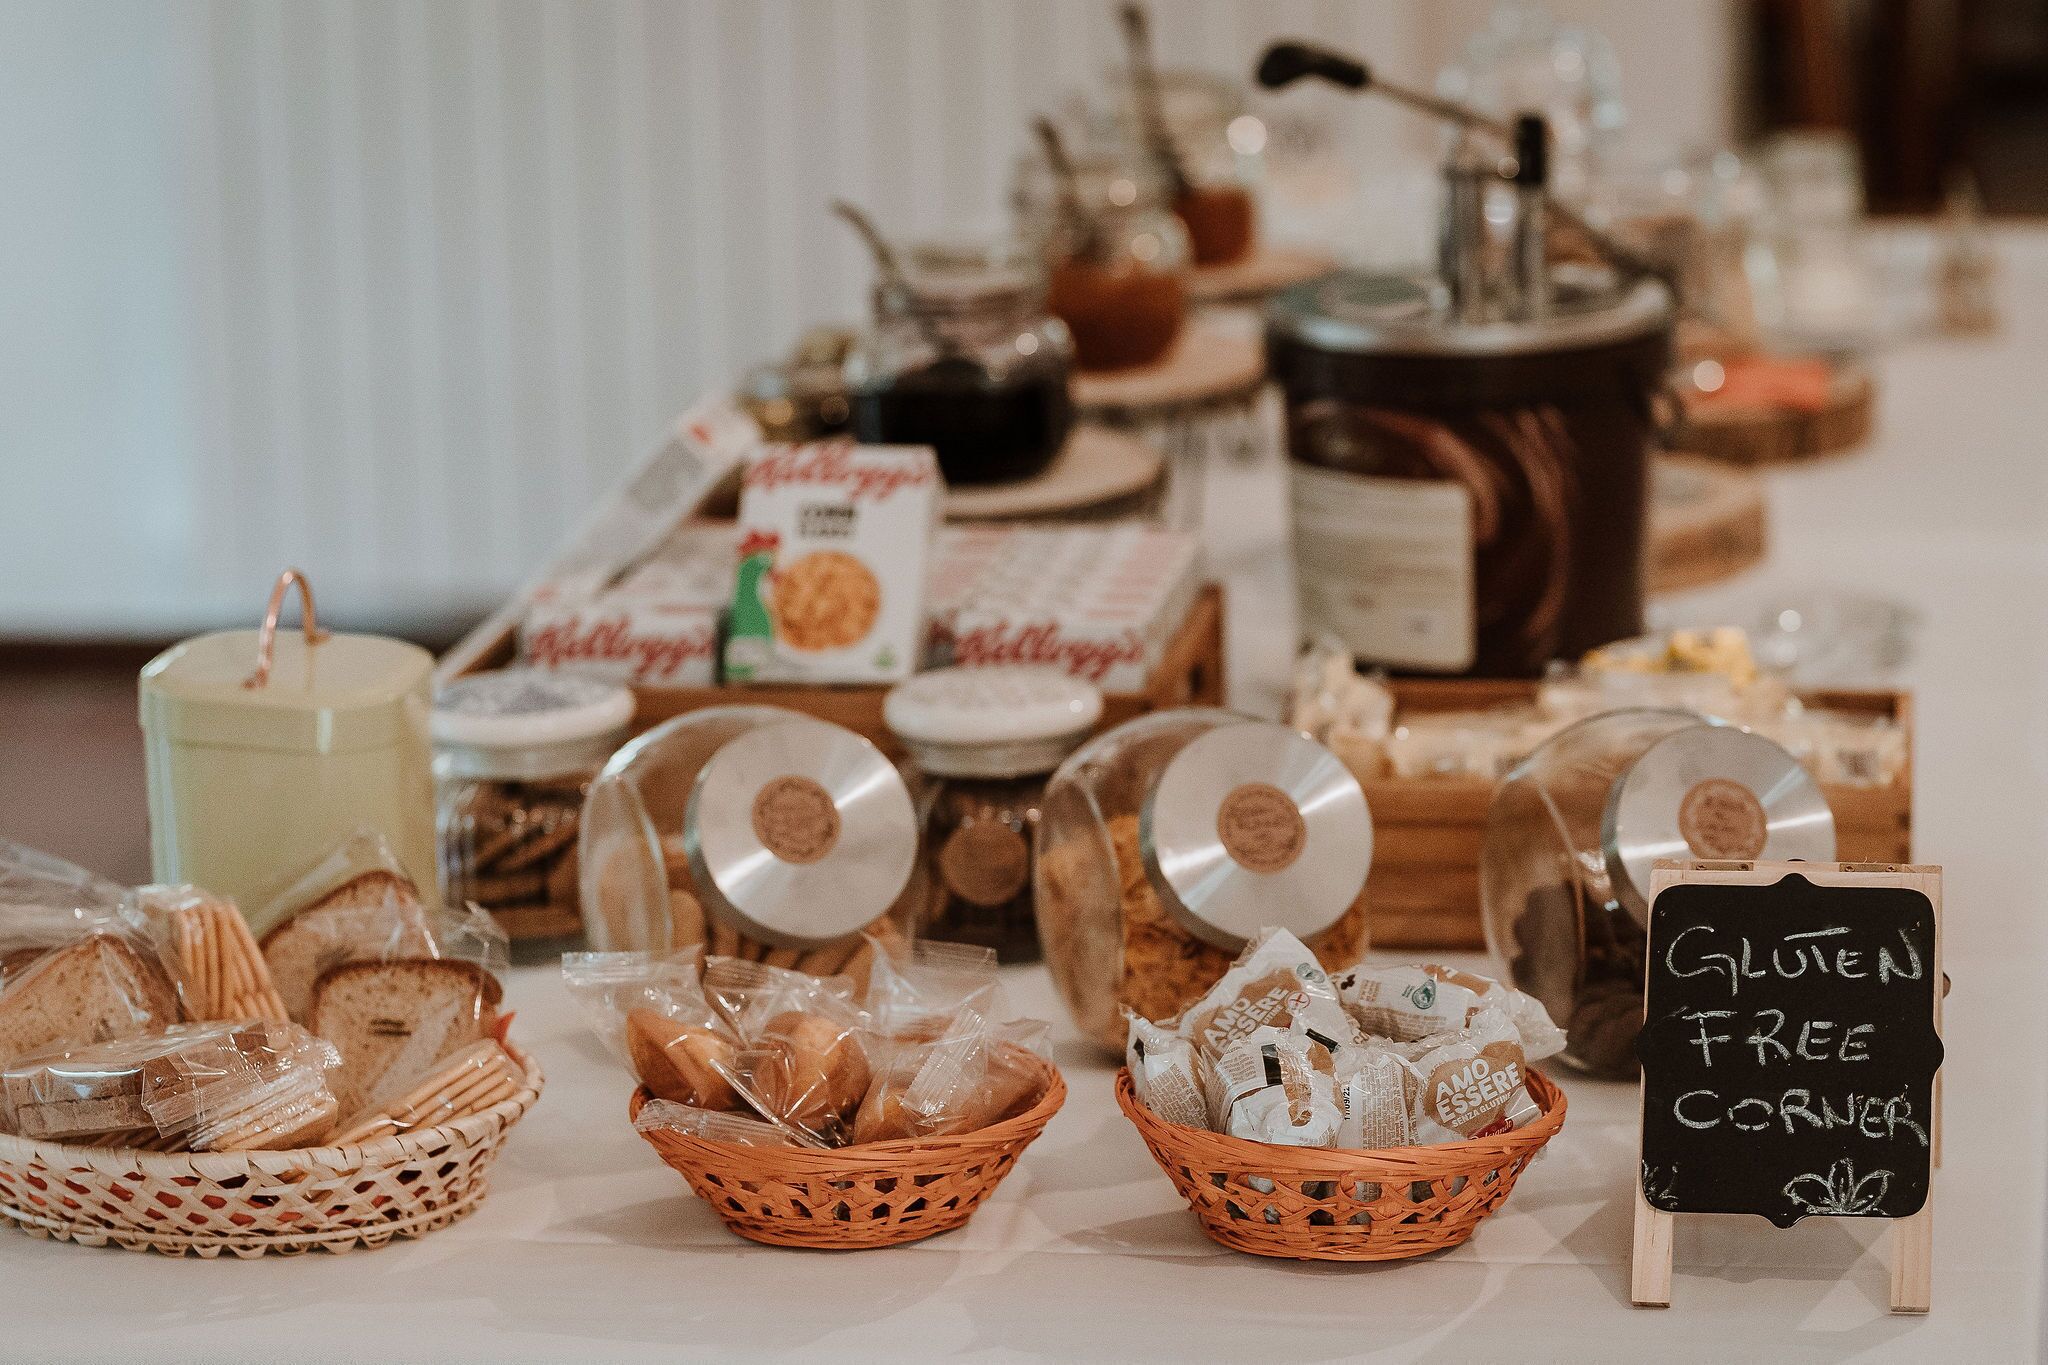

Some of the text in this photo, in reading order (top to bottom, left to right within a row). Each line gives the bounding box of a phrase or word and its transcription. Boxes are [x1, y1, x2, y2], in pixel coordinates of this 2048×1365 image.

[1665, 925, 1923, 997] GLUTEN
[1203, 997, 1251, 1046] AMO
[1682, 1008, 1875, 1067] FREE
[1436, 1058, 1490, 1102] AMO
[1436, 1061, 1522, 1124] ESSERE
[1451, 1108, 1481, 1128] SENZA
[1673, 1088, 1928, 1147] CORNER
